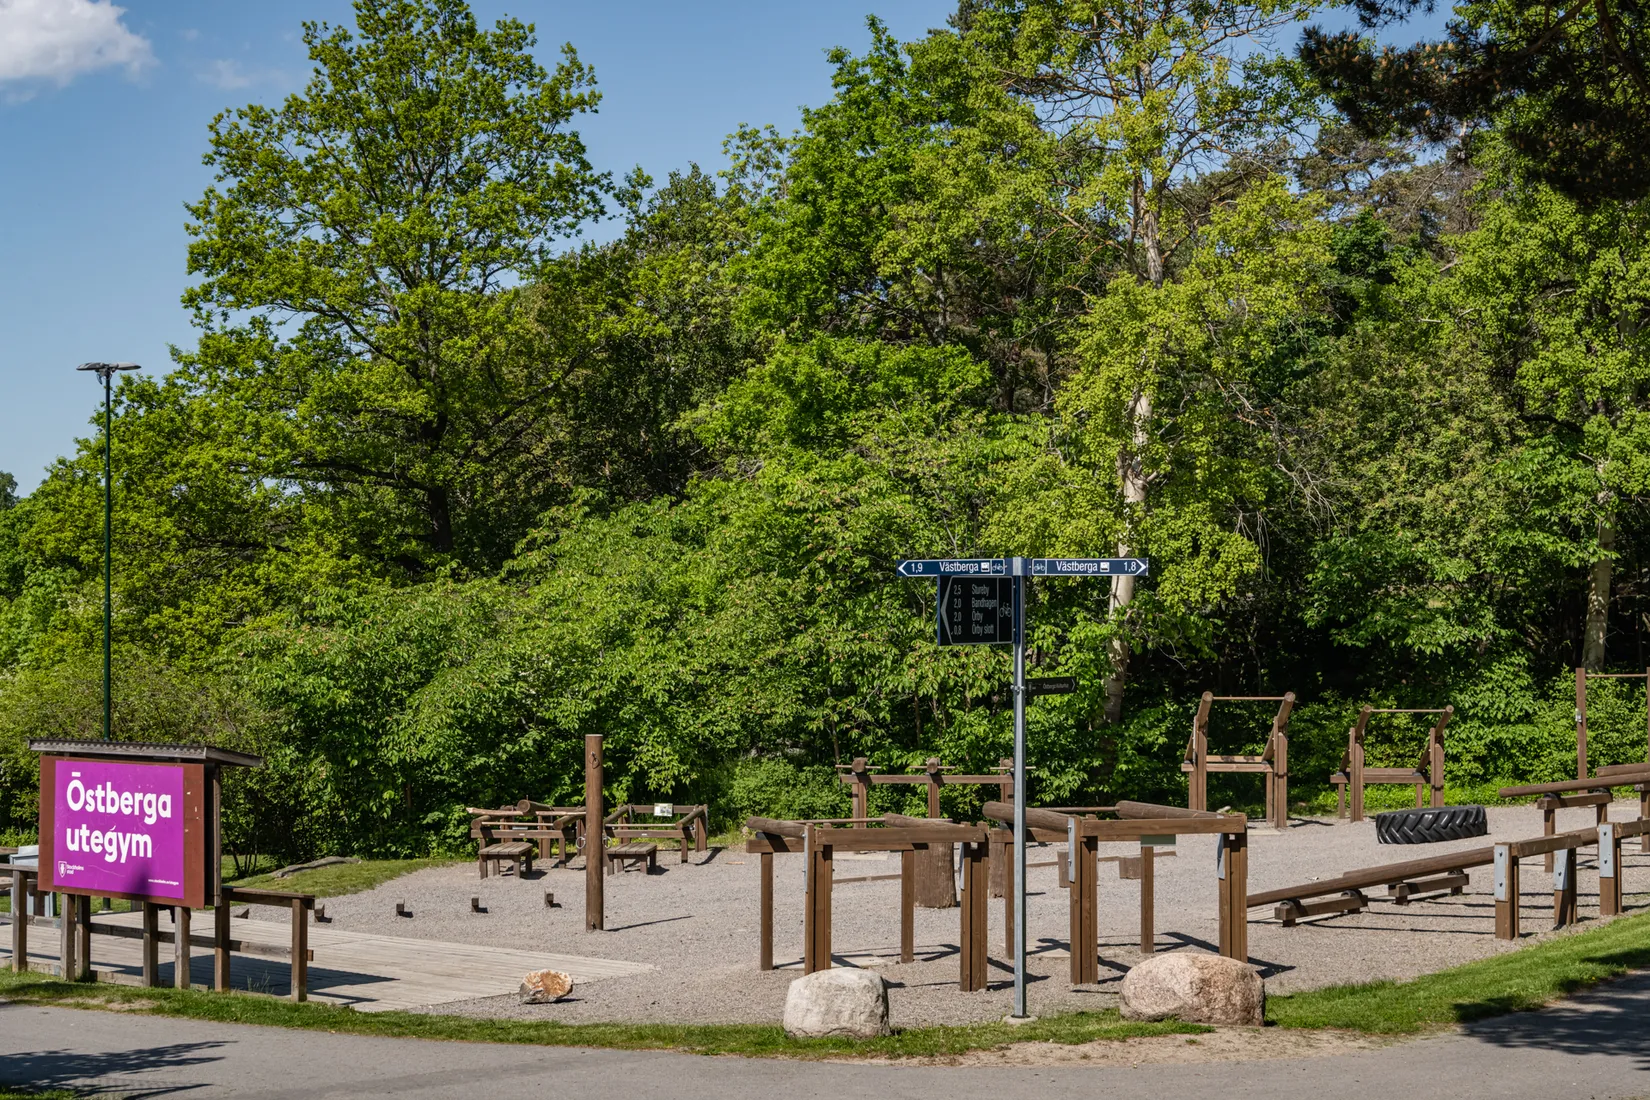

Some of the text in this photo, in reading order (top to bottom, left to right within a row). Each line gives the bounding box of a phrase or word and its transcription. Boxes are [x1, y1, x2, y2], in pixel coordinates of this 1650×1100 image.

[911, 561, 979, 573] 1,9 Västberga
[1056, 560, 1137, 572] Västberga 1,8
[953, 584, 962, 595] 2,5
[953, 597, 997, 610] 2,0 Bandhagen
[953, 610, 983, 624] 2,0 Örby
[971, 624, 983, 637] Örby
